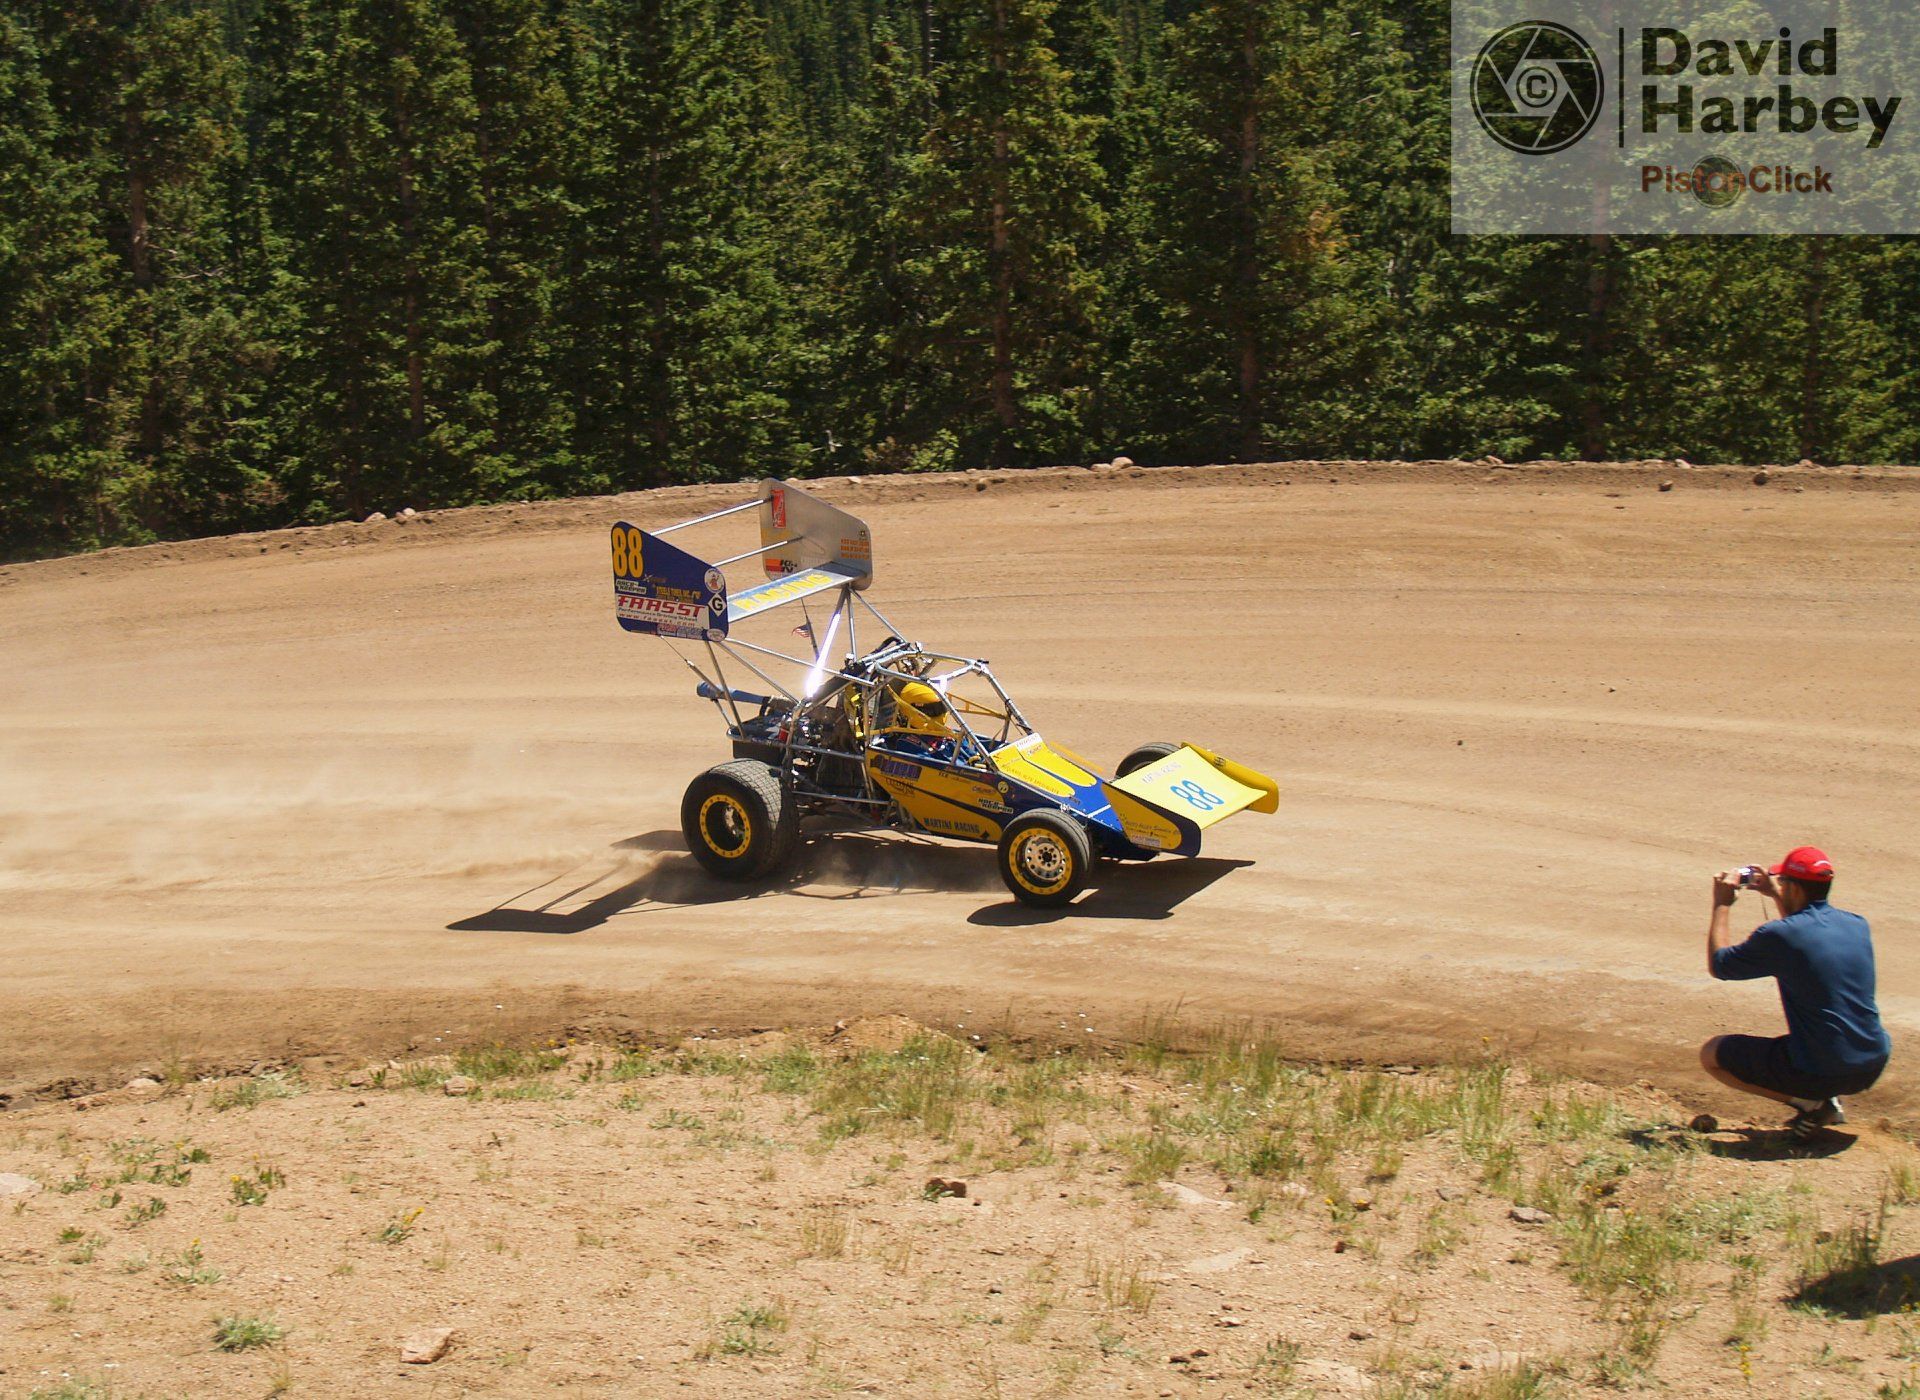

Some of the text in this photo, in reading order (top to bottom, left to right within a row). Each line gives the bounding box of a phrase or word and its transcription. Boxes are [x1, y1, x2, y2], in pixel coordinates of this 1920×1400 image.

[612, 527, 644, 578] 88
[618, 595, 705, 617] FAASST
[712, 598, 723, 611] G
[1170, 780, 1224, 811] 88
